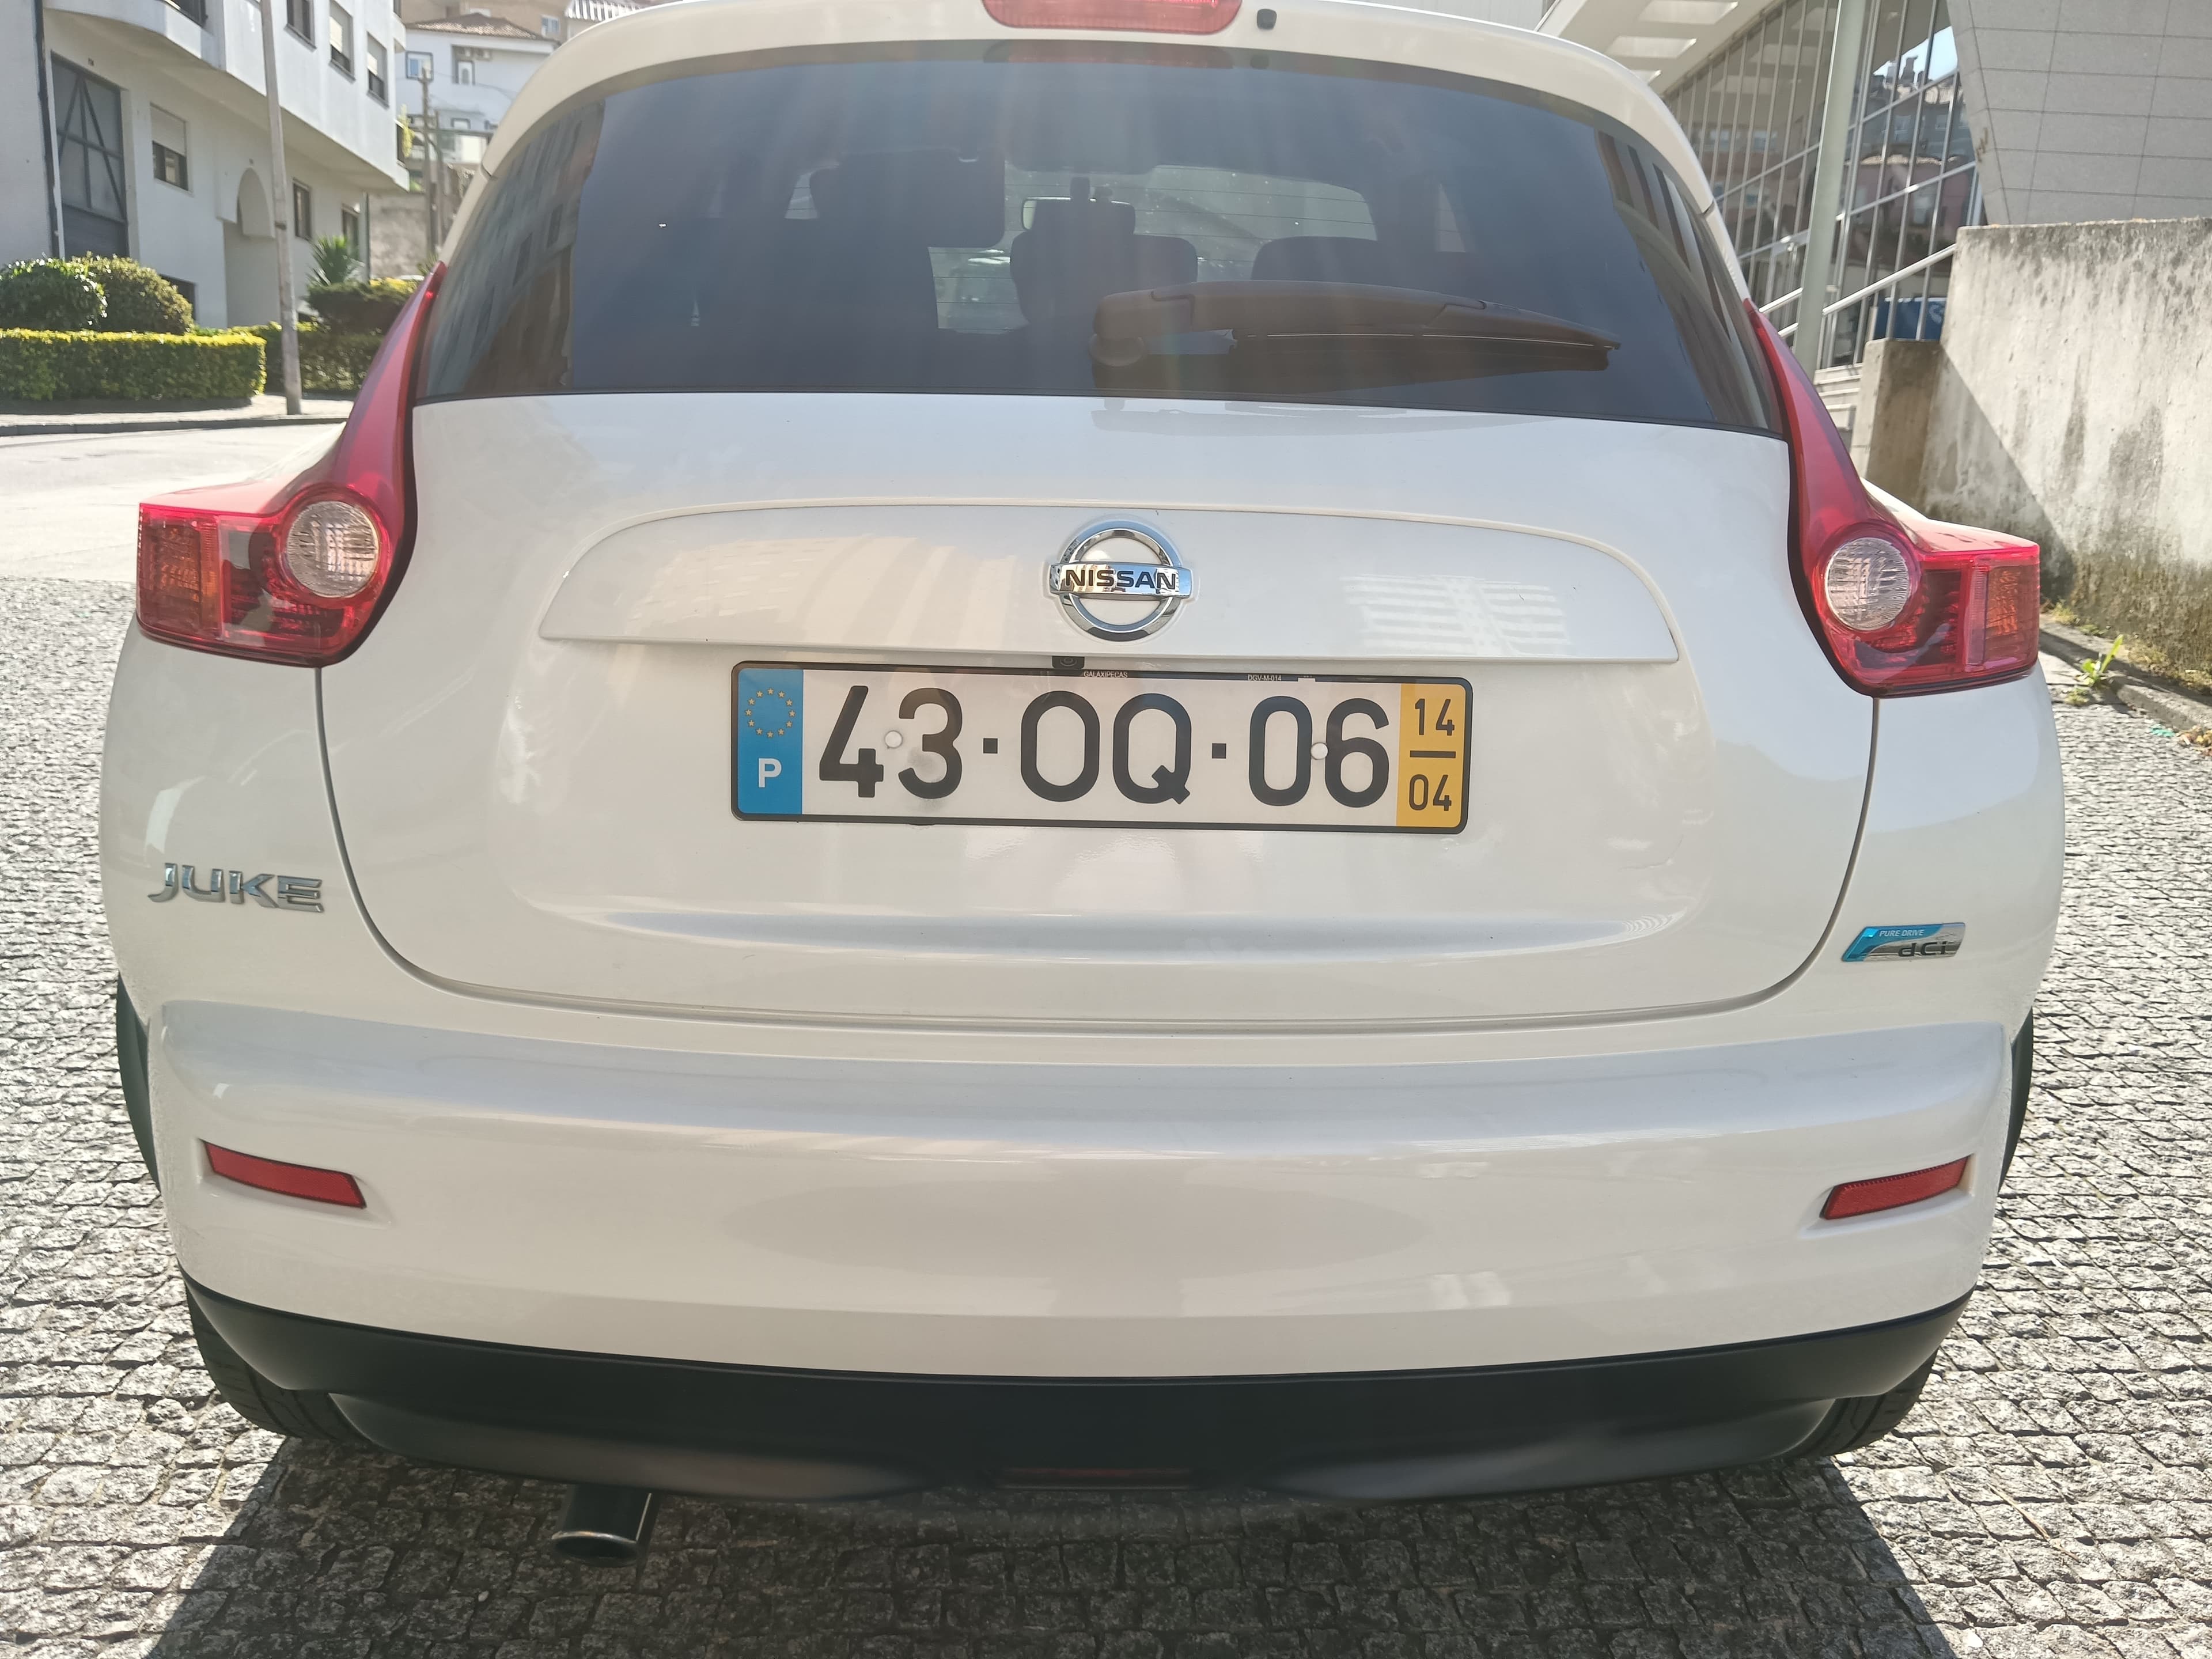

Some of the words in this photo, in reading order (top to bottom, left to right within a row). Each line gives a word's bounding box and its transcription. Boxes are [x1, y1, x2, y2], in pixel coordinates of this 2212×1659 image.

[1066, 569, 1176, 590] NISSAN
[1415, 698, 1455, 736] 14
[759, 759, 782, 787] P
[1408, 774, 1452, 812] 04
[147, 862, 324, 913] JUKE
